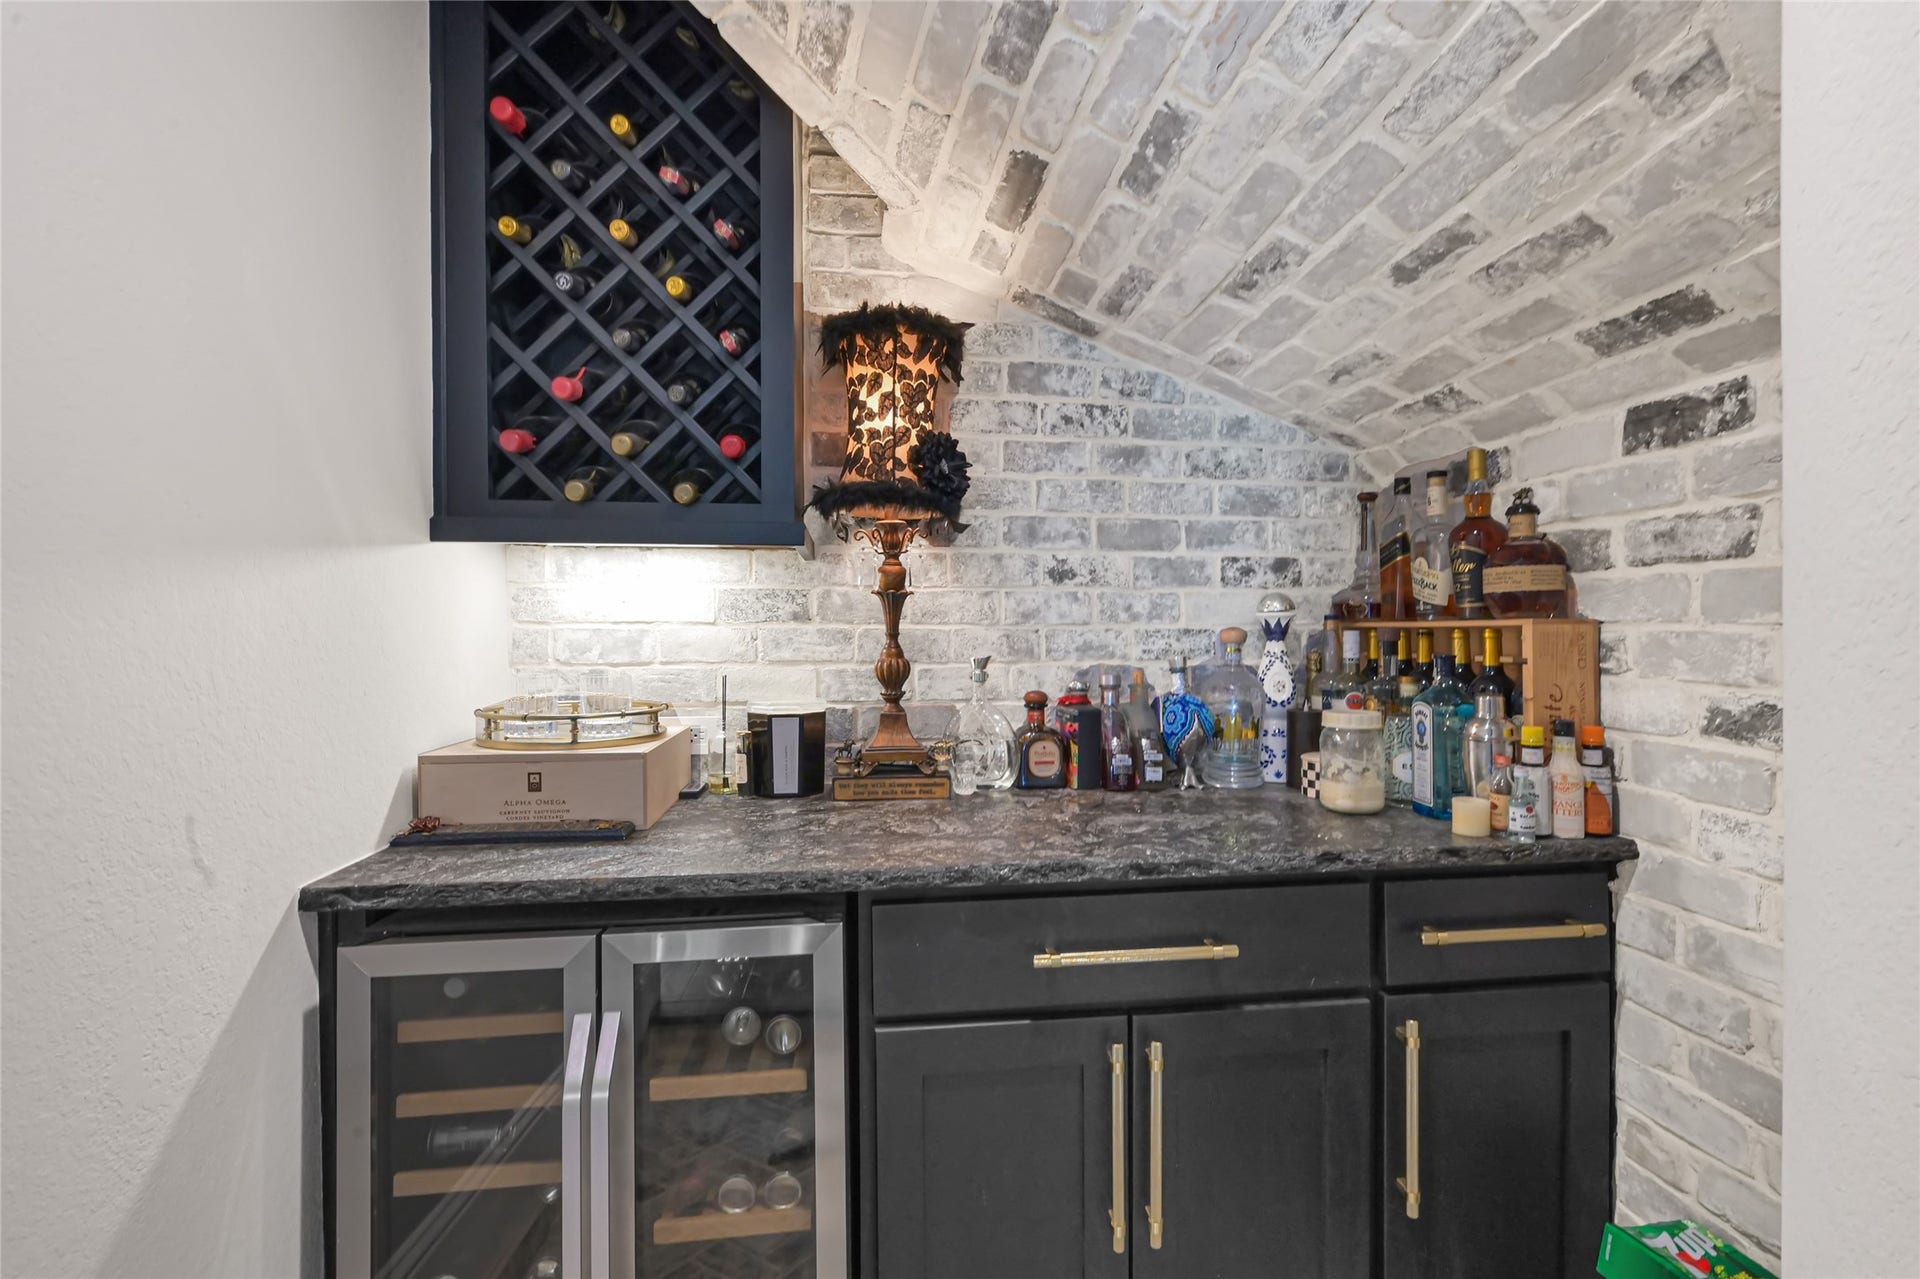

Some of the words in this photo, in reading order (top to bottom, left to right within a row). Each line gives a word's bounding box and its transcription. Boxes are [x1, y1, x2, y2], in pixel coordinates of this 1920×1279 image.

[871, 781, 886, 789] will
[504, 799, 531, 807] ALPHA
[535, 798, 567, 806] OMEGA
[1642, 1227, 1717, 1279] 7UP
